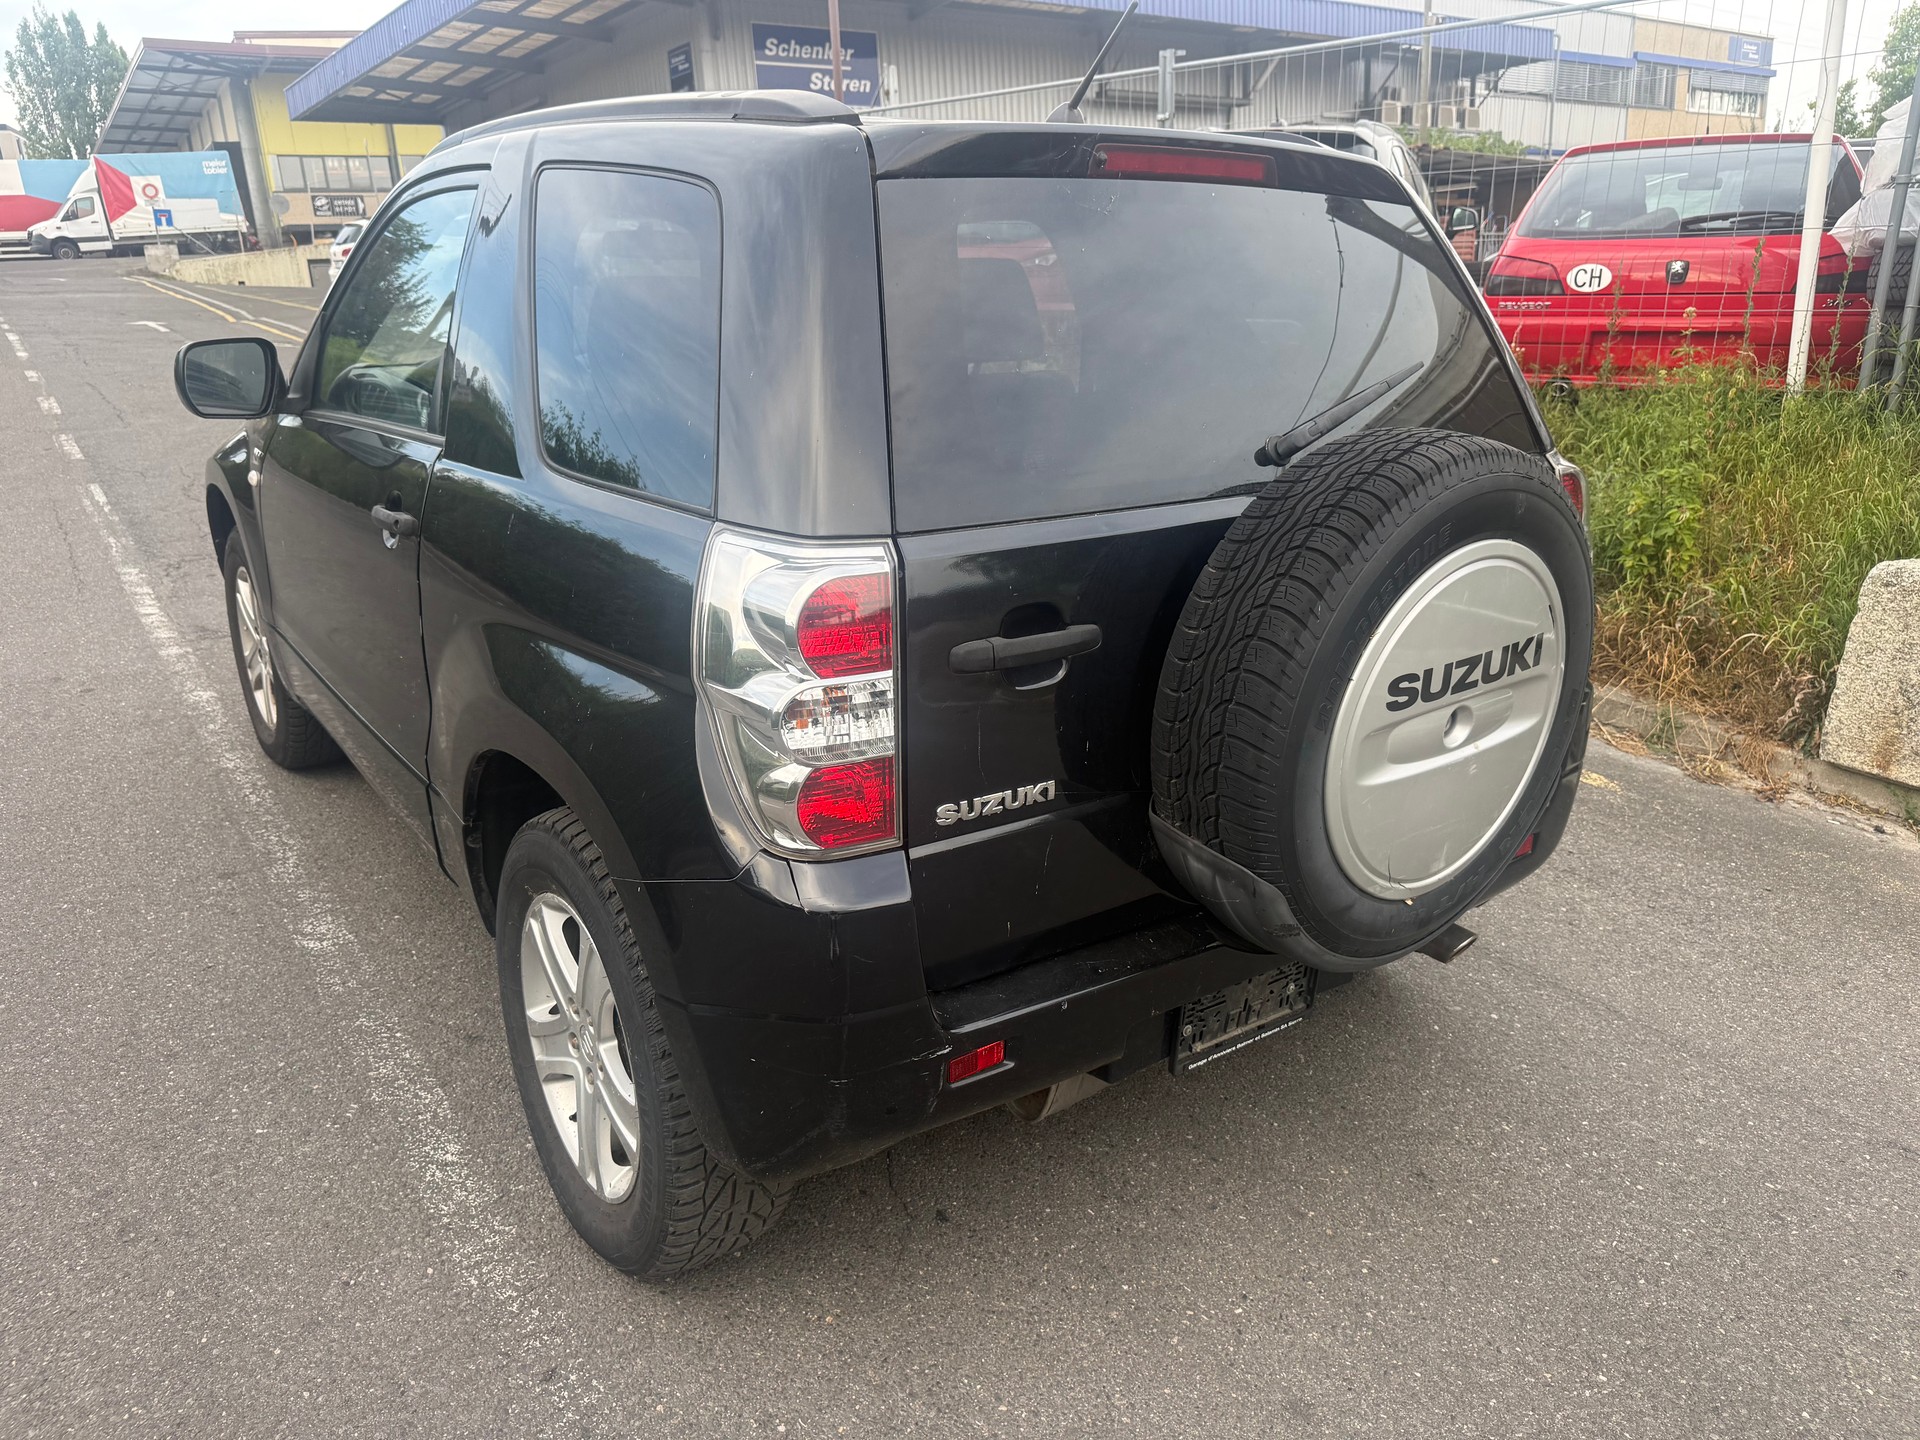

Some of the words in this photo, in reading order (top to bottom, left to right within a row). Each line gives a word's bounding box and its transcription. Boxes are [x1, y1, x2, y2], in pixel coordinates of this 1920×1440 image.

[1574, 268, 1603, 288] CH
[1498, 301, 1552, 310] PEUGEOT
[1385, 632, 1544, 712] SUZUKI
[936, 780, 1056, 826] SUZUKI
